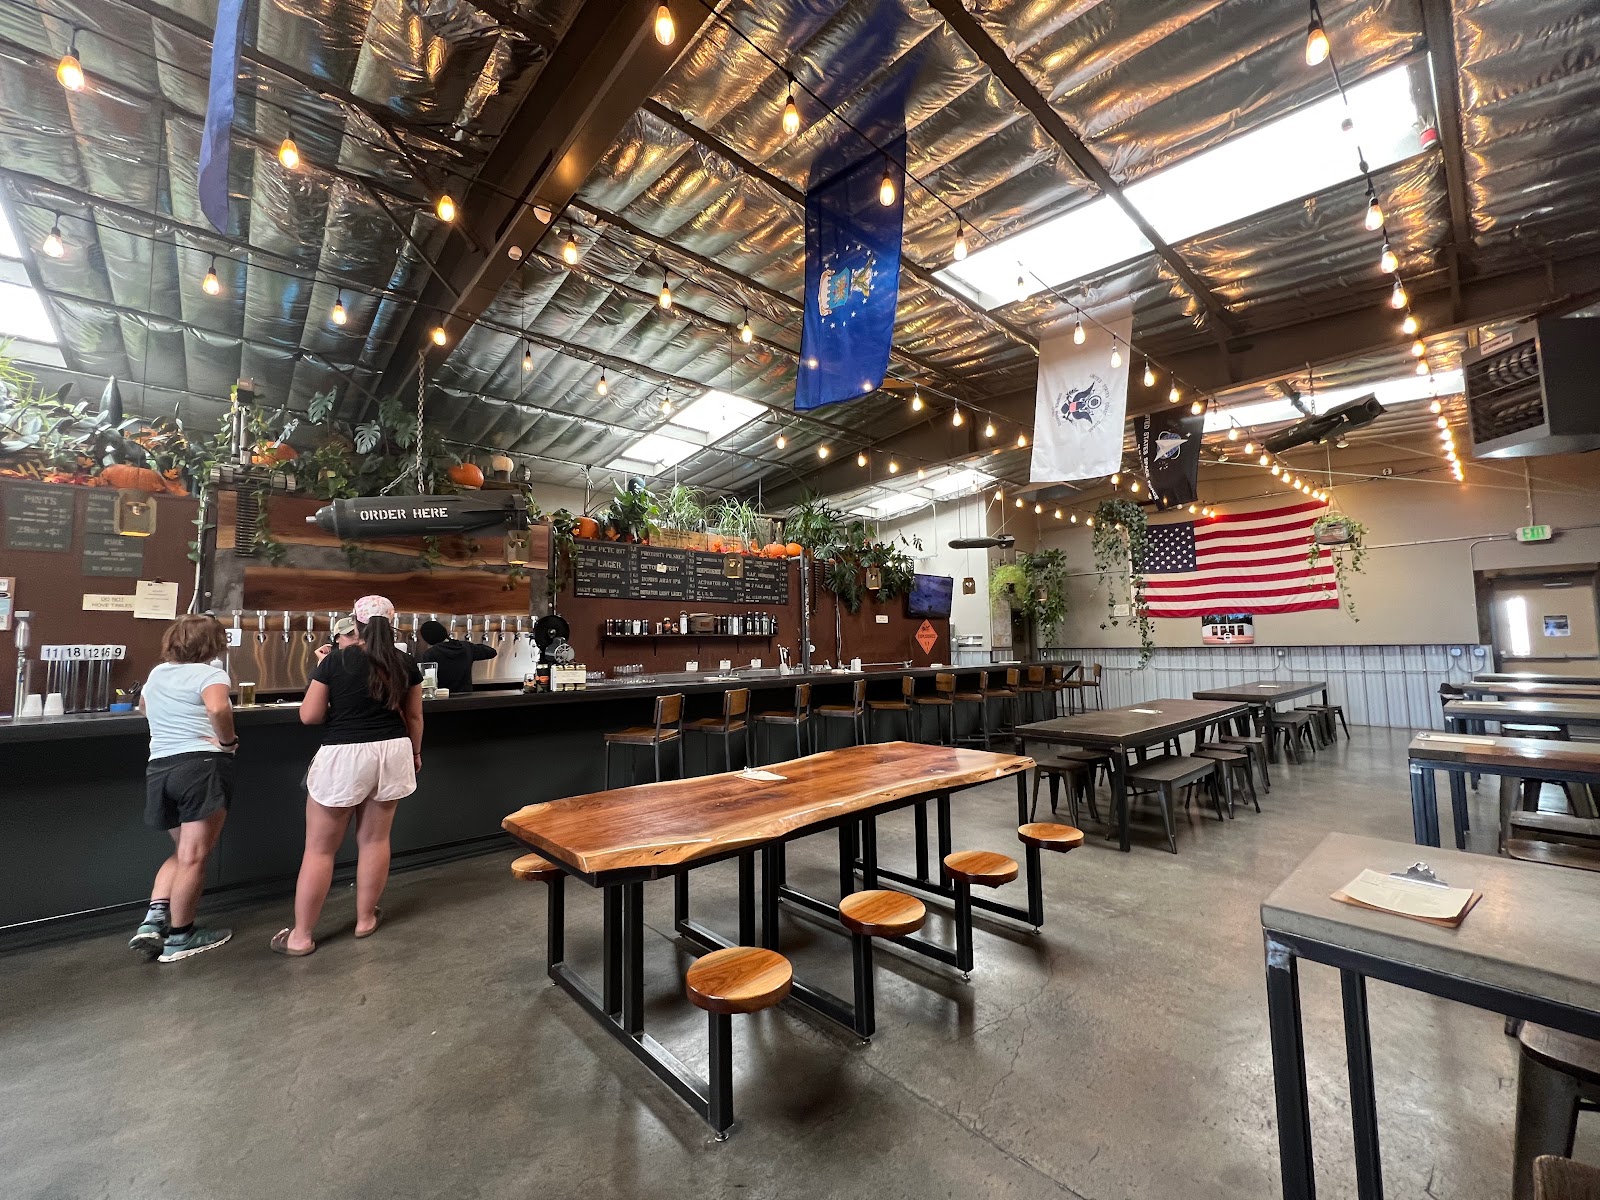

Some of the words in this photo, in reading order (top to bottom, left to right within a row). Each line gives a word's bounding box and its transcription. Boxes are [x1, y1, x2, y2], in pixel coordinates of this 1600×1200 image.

[1147, 480, 1160, 501] FORCE
[360, 508, 407, 521] ORDER
[412, 507, 449, 519] HERE
[1521, 525, 1547, 540] EXIT
[598, 560, 622, 568] LAGER
[45, 648, 58, 658] 11
[67, 647, 81, 658] 18
[88, 648, 99, 658] 12
[114, 647, 122, 658] 9
